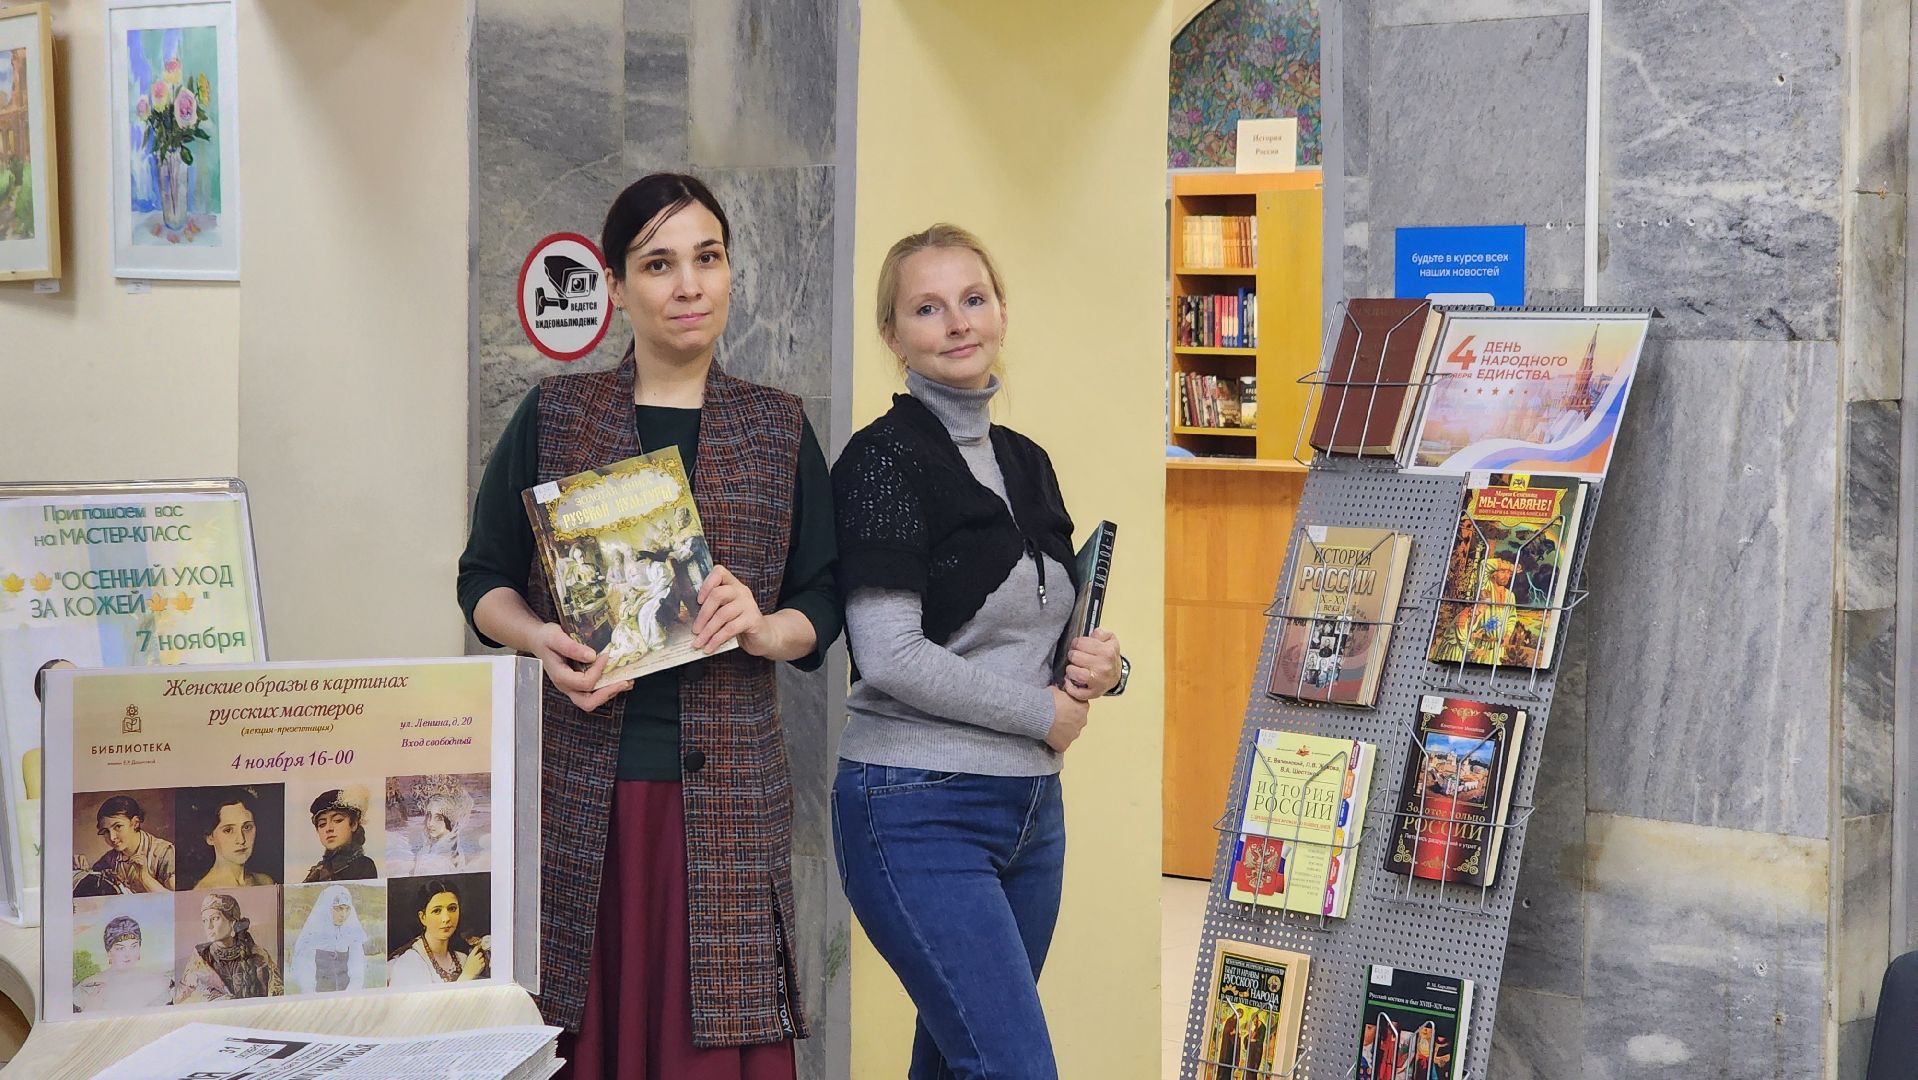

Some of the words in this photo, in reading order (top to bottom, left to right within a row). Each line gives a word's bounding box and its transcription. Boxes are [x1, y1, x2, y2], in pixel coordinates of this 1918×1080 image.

[1411, 252, 1445, 265] будьте
[1446, 254, 1452, 262] в
[1453, 253, 1484, 265] курсе
[1485, 253, 1509, 262] всех
[1419, 268, 1451, 278] наших
[1452, 265, 1500, 277] новостей
[571, 301, 598, 312] ВЕДЕТСЯ
[535, 317, 598, 329] ВИДЕОНАБЛЮДЕНИЕ
[1446, 335, 1477, 370] 4
[1483, 341, 1522, 354] ДЕНЬ
[1480, 355, 1568, 368] НАРОДНОГО
[1476, 368, 1551, 381] ЕДИНСТВА
[1478, 496, 1553, 512] МЫ-СЛАВЯНЕ!
[43, 505, 146, 524] Приглашаем
[155, 505, 185, 517] вас
[34, 534, 58, 547] на
[60, 525, 192, 545] МАСТЕР-КЛАСС
[1314, 548, 1373, 565] ИСТОРИЯ
[171, 564, 234, 588] УХОД
[1299, 566, 1376, 595] РОССИИ
[30, 597, 58, 619] ЗА
[64, 590, 146, 617] КОЖЕЙ
[136, 629, 153, 652] 7
[158, 626, 246, 653] ноября
[163, 679, 243, 697] Женские
[244, 675, 308, 698] образы
[310, 679, 319, 691] в
[323, 676, 409, 694] картинах
[208, 706, 279, 726] русских
[281, 702, 365, 721] мастеров
[400, 721, 414, 730] ул.
[415, 718, 451, 729] Ленина,
[460, 716, 473, 726] 20
[91, 742, 172, 756] БИБЛИОТЕКА
[401, 738, 424, 748] Вход
[425, 736, 472, 748] свободный
[231, 755, 241, 770] 4
[245, 751, 304, 771] ноября
[308, 749, 354, 767] 16-00
[1256, 780, 1335, 804] ИСТОРИЯ
[1254, 794, 1333, 821] РОССИИ
[1450, 809, 1485, 823] ольцо
[1402, 816, 1485, 842] РОССИИ
[775, 923, 783, 953] TORY
[779, 1002, 793, 1034] TORY
[1222, 973, 1259, 988] РУССКОГО
[1250, 989, 1279, 1005] НАРОДА
